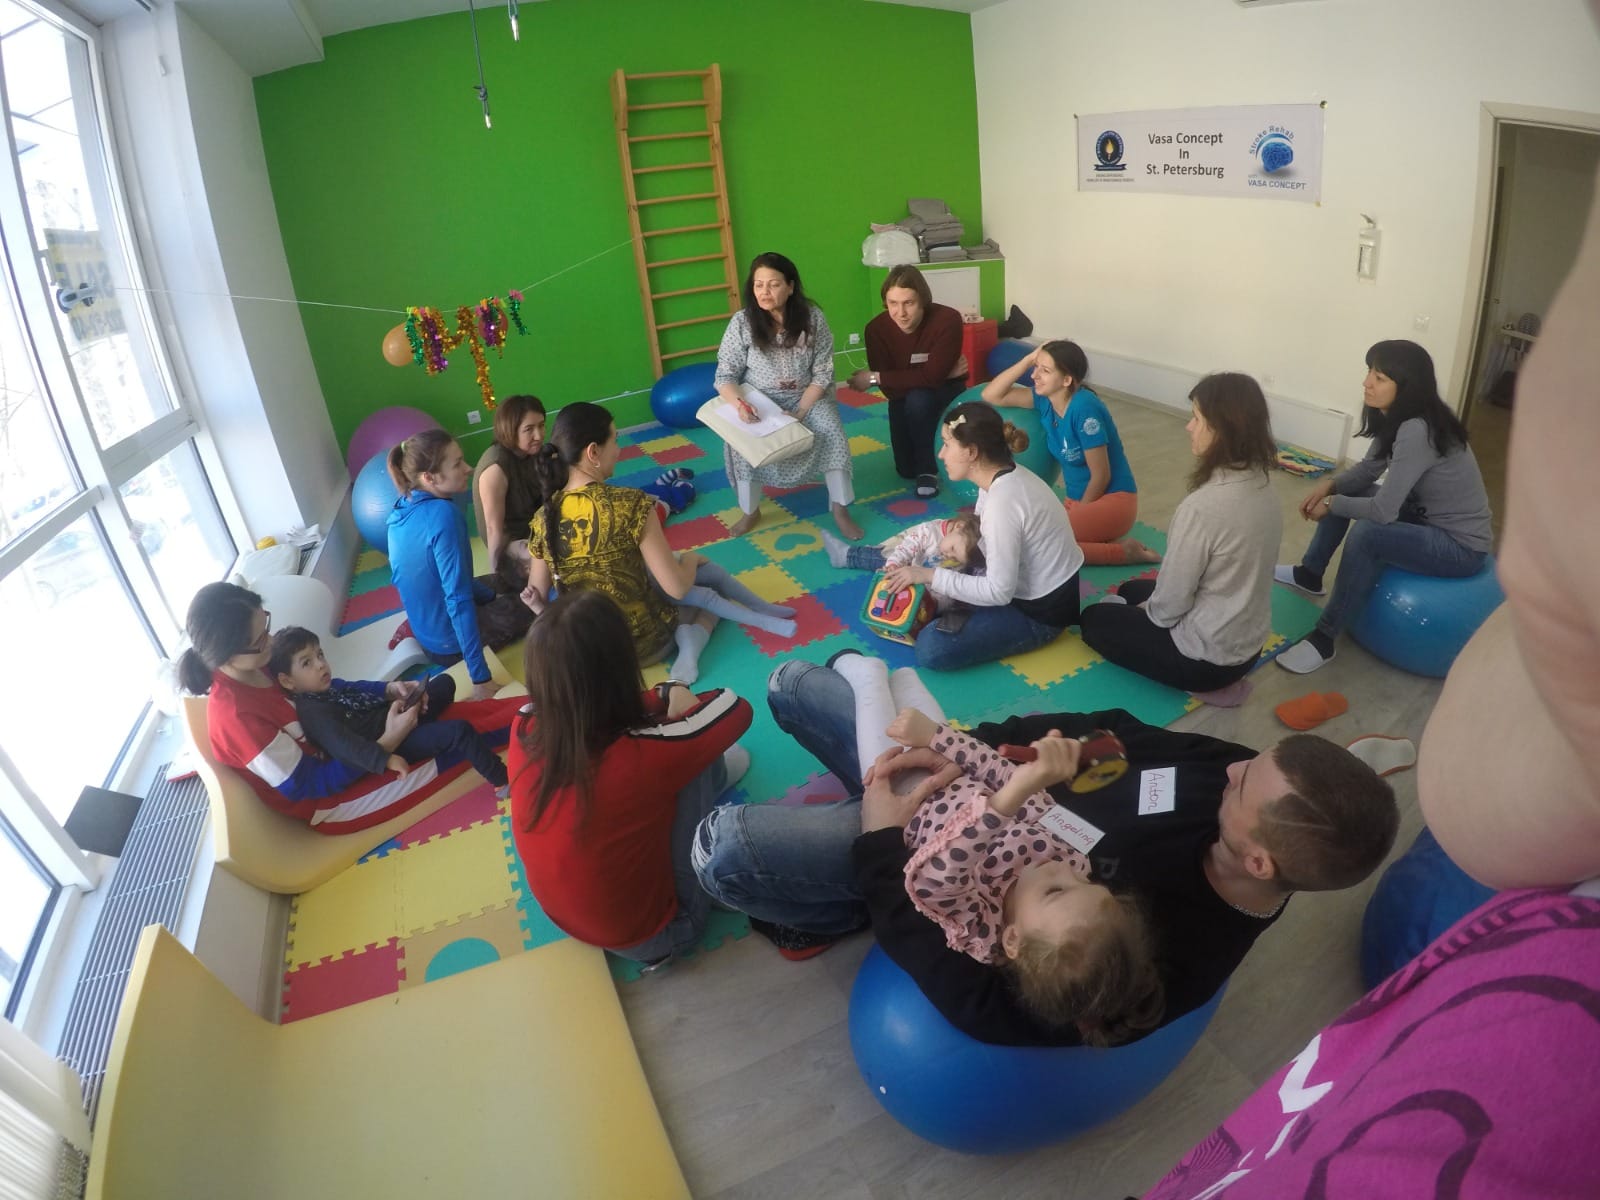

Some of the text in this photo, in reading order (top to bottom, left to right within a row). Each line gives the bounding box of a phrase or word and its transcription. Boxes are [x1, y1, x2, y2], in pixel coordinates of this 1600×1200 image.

[1148, 132, 1223, 146] Vasa Concept
[1249, 125, 1295, 155] Stroke Rehab
[1179, 148, 1190, 159] In
[1146, 163, 1225, 179] St. Petersburg
[1248, 179, 1306, 190] VASA CONCEPT
[1148, 771, 1165, 811] Anton
